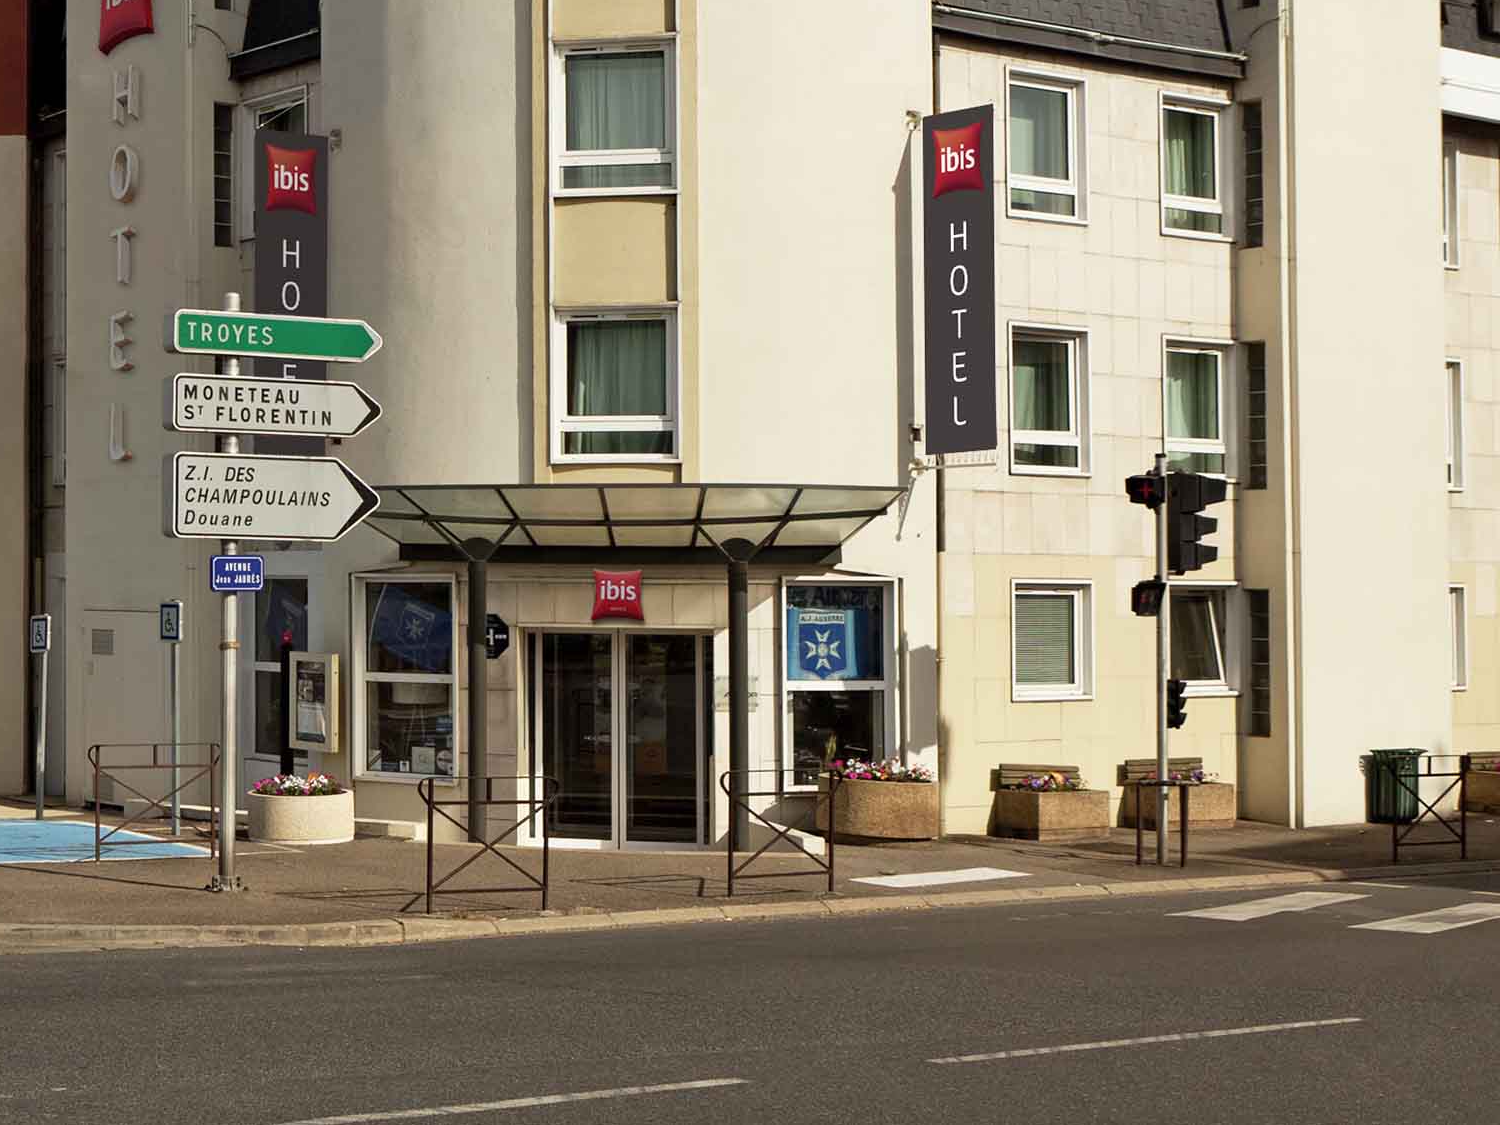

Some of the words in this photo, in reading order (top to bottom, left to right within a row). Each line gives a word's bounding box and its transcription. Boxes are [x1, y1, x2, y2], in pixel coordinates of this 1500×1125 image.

[940, 143, 976, 174] ibis
[273, 164, 310, 192] ibis
[109, 65, 140, 460] HOTEL
[187, 321, 275, 346] TROYES
[949, 221, 968, 426] HOTEL
[184, 384, 300, 405] MONETEAU
[216, 406, 332, 426] FLORENTIN
[185, 465, 213, 481] Z.I.
[225, 466, 256, 482] DES
[185, 487, 332, 507] CHAMPOULAINS
[184, 509, 254, 526] Douane
[225, 562, 252, 572] AVENUE
[600, 579, 637, 601] ibis
